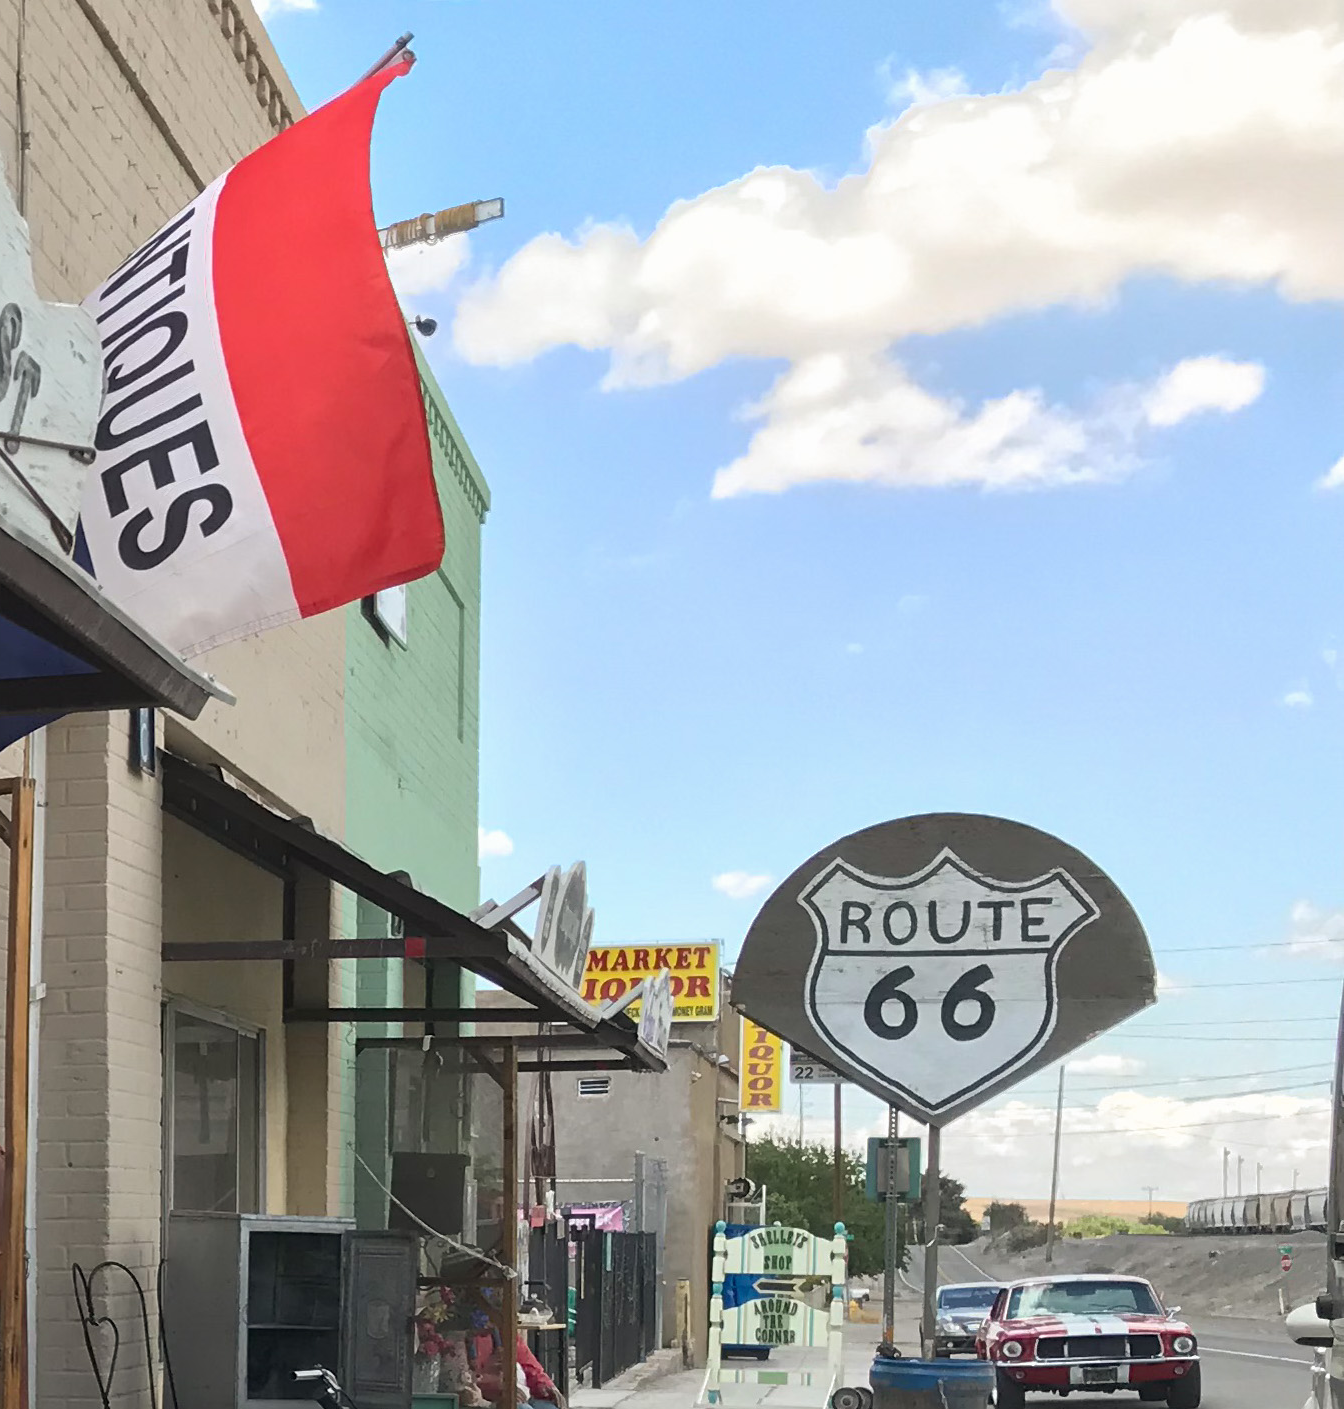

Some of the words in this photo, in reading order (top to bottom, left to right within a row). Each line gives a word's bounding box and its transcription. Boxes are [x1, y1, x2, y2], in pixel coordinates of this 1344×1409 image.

[840, 897, 1053, 946] ROUTE
[586, 946, 711, 972] MARKET
[864, 963, 996, 1041] 66
[747, 1023, 774, 1106] IQUOR
[794, 1066, 814, 1080] 22
[763, 1255, 793, 1271] SHOP
[754, 1298, 799, 1316] AROUND
[763, 1314, 784, 1330] THE
[755, 1328, 796, 1345] CORNER
